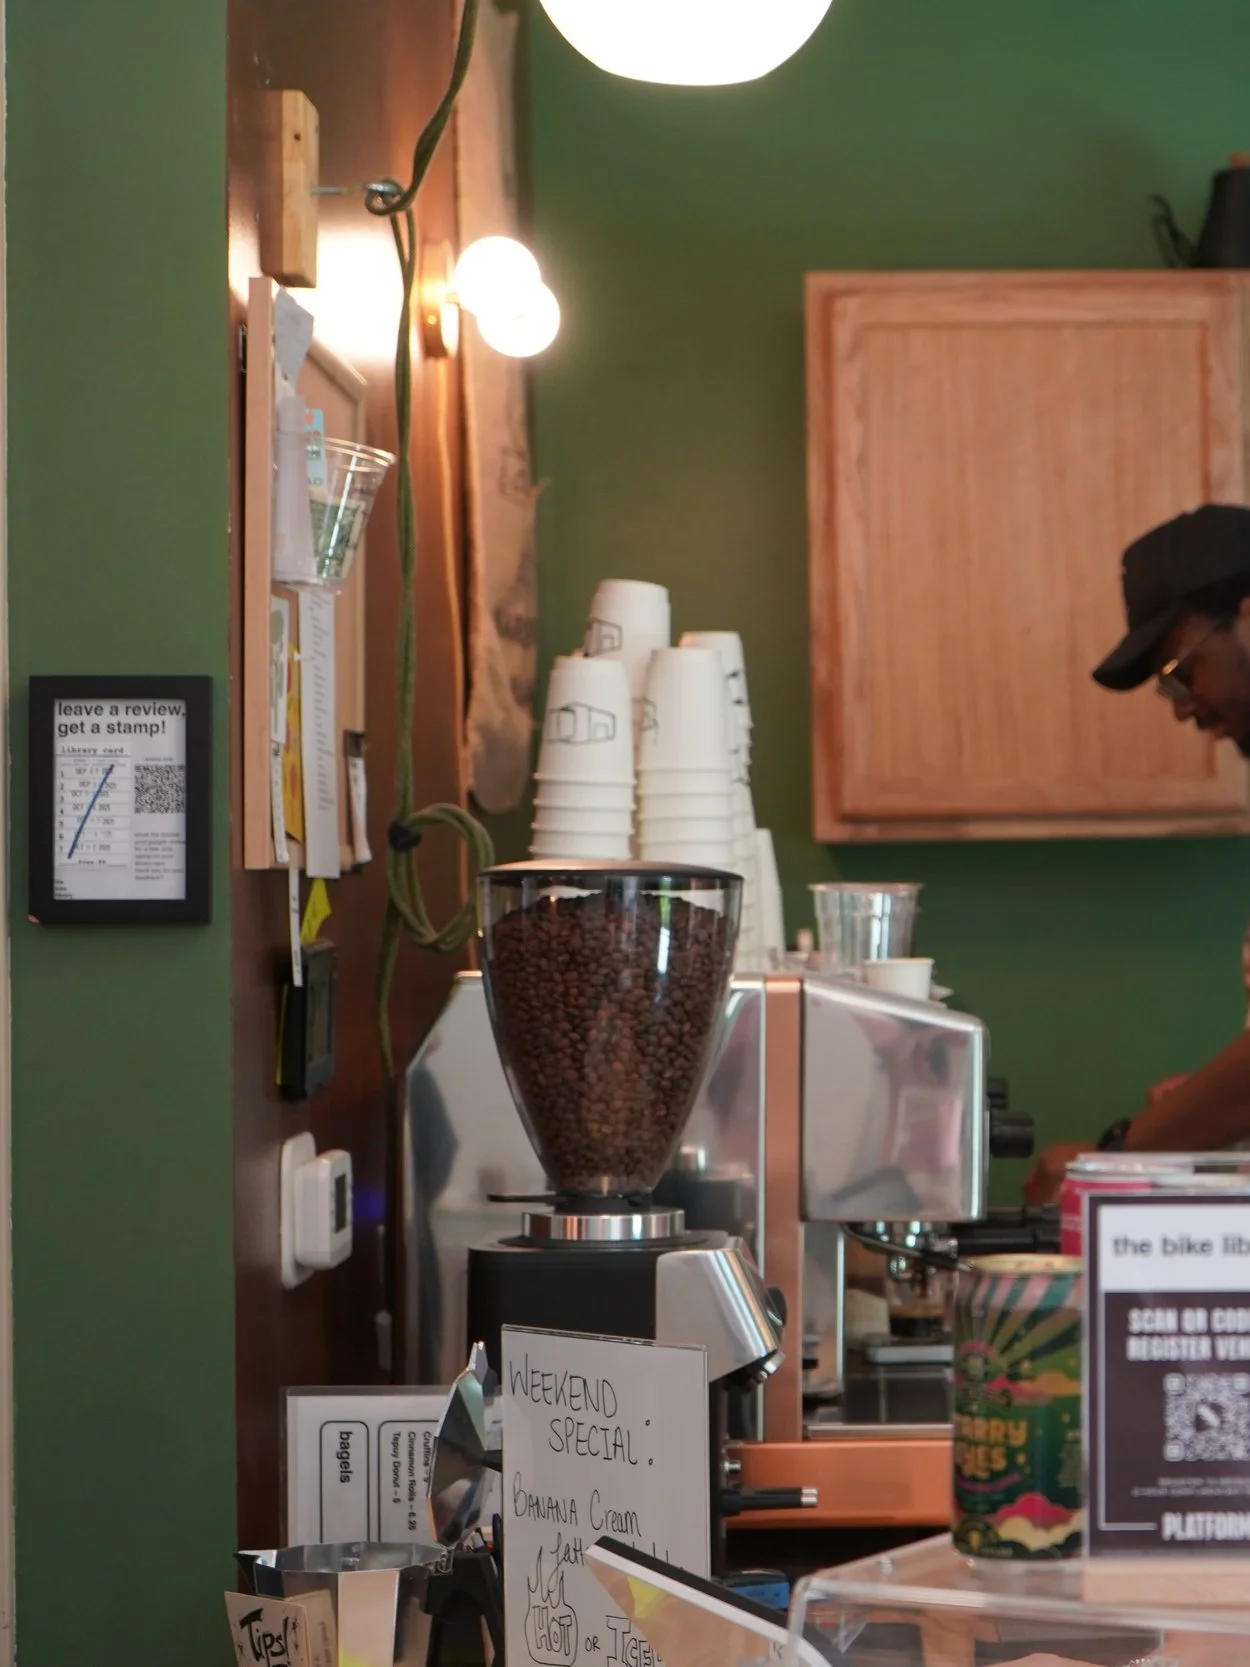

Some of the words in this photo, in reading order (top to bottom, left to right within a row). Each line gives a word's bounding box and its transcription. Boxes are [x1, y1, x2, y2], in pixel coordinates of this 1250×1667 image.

[58, 701, 104, 716] leave
[109, 704, 119, 716] a
[125, 701, 186, 718] review,
[58, 721, 86, 738] get
[91, 722, 100, 734] a
[107, 720, 166, 737] stamp!
[61, 746, 98, 755] library
[102, 746, 124, 754] card
[1113, 1233, 1152, 1257] the
[1161, 1233, 1214, 1257] bike
[1128, 1307, 1179, 1334] SCAN
[1181, 1307, 1208, 1335] QR
[1126, 1335, 1212, 1362] REGISTER
[509, 1352, 618, 1419] WEEKEND
[336, 1431, 353, 1483] bagels
[407, 1431, 417, 1477] Cinnamon
[393, 1461, 401, 1488] Donut
[407, 1479, 417, 1502] Rolls
[513, 1471, 578, 1526] BANANA
[590, 1489, 642, 1537] Cream
[239, 1608, 291, 1667] Tips!
[533, 1605, 572, 1657] HOT
[585, 1635, 600, 1652] OR
